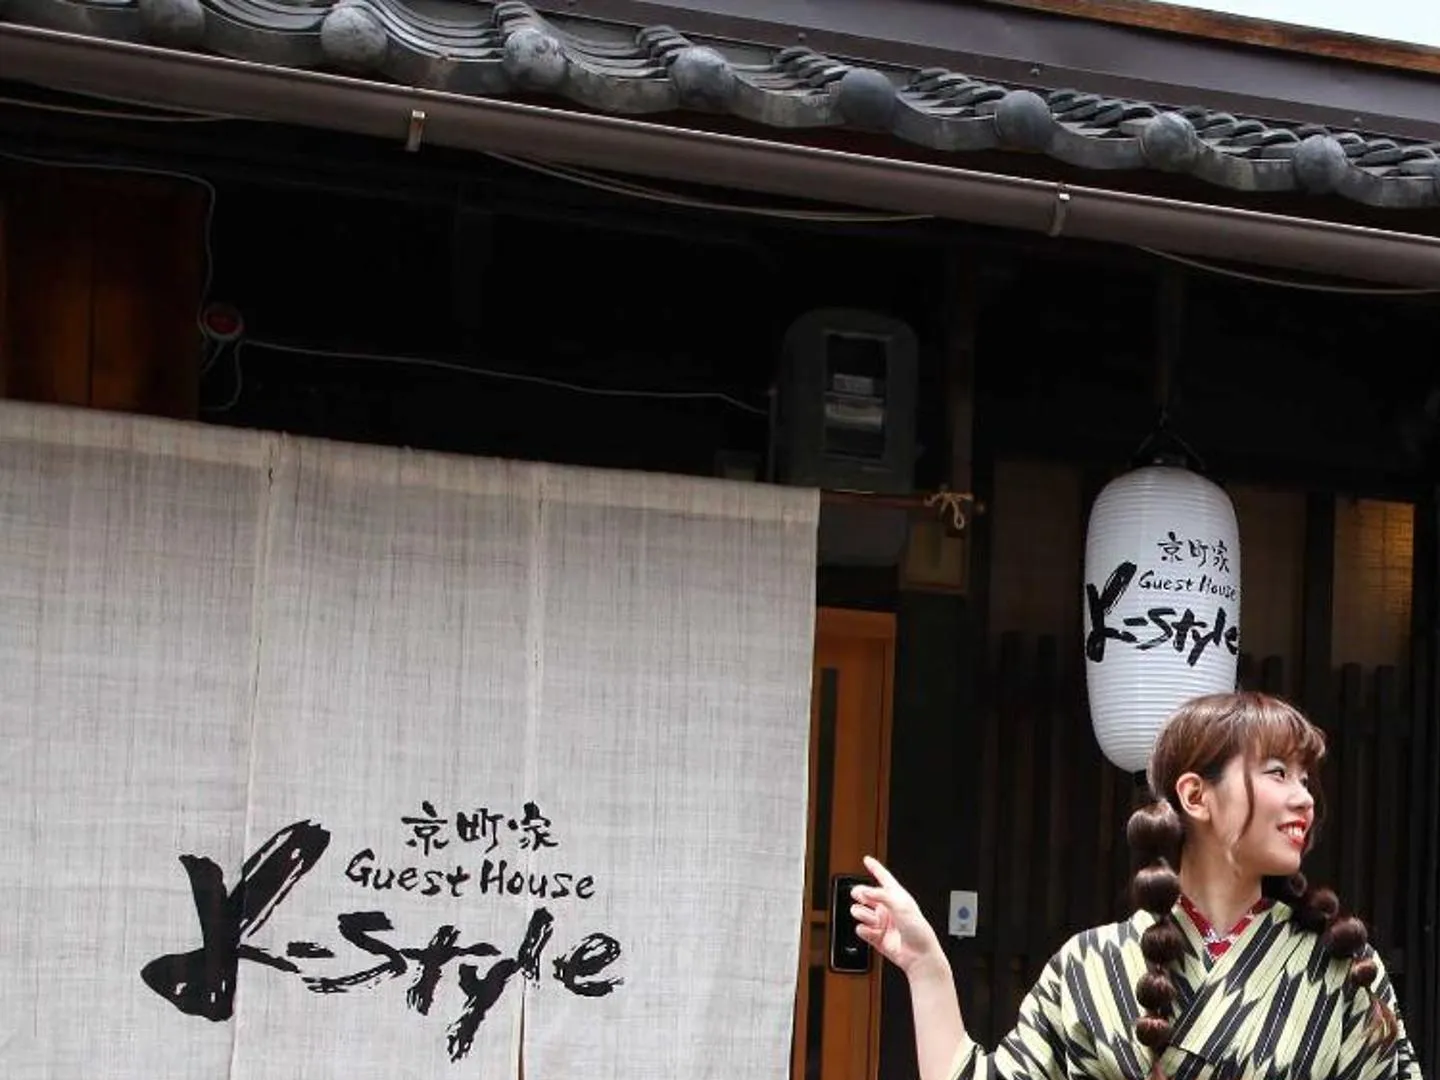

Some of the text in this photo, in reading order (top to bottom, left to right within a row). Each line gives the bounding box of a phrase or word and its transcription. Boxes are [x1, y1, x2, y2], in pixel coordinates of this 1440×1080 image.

[1157, 531, 1230, 573] 京町家
[1138, 569, 1237, 601] Guest House
[401, 800, 559, 854] 京町家
[344, 848, 596, 900] Guest House
[140, 817, 624, 1063] K-Style
